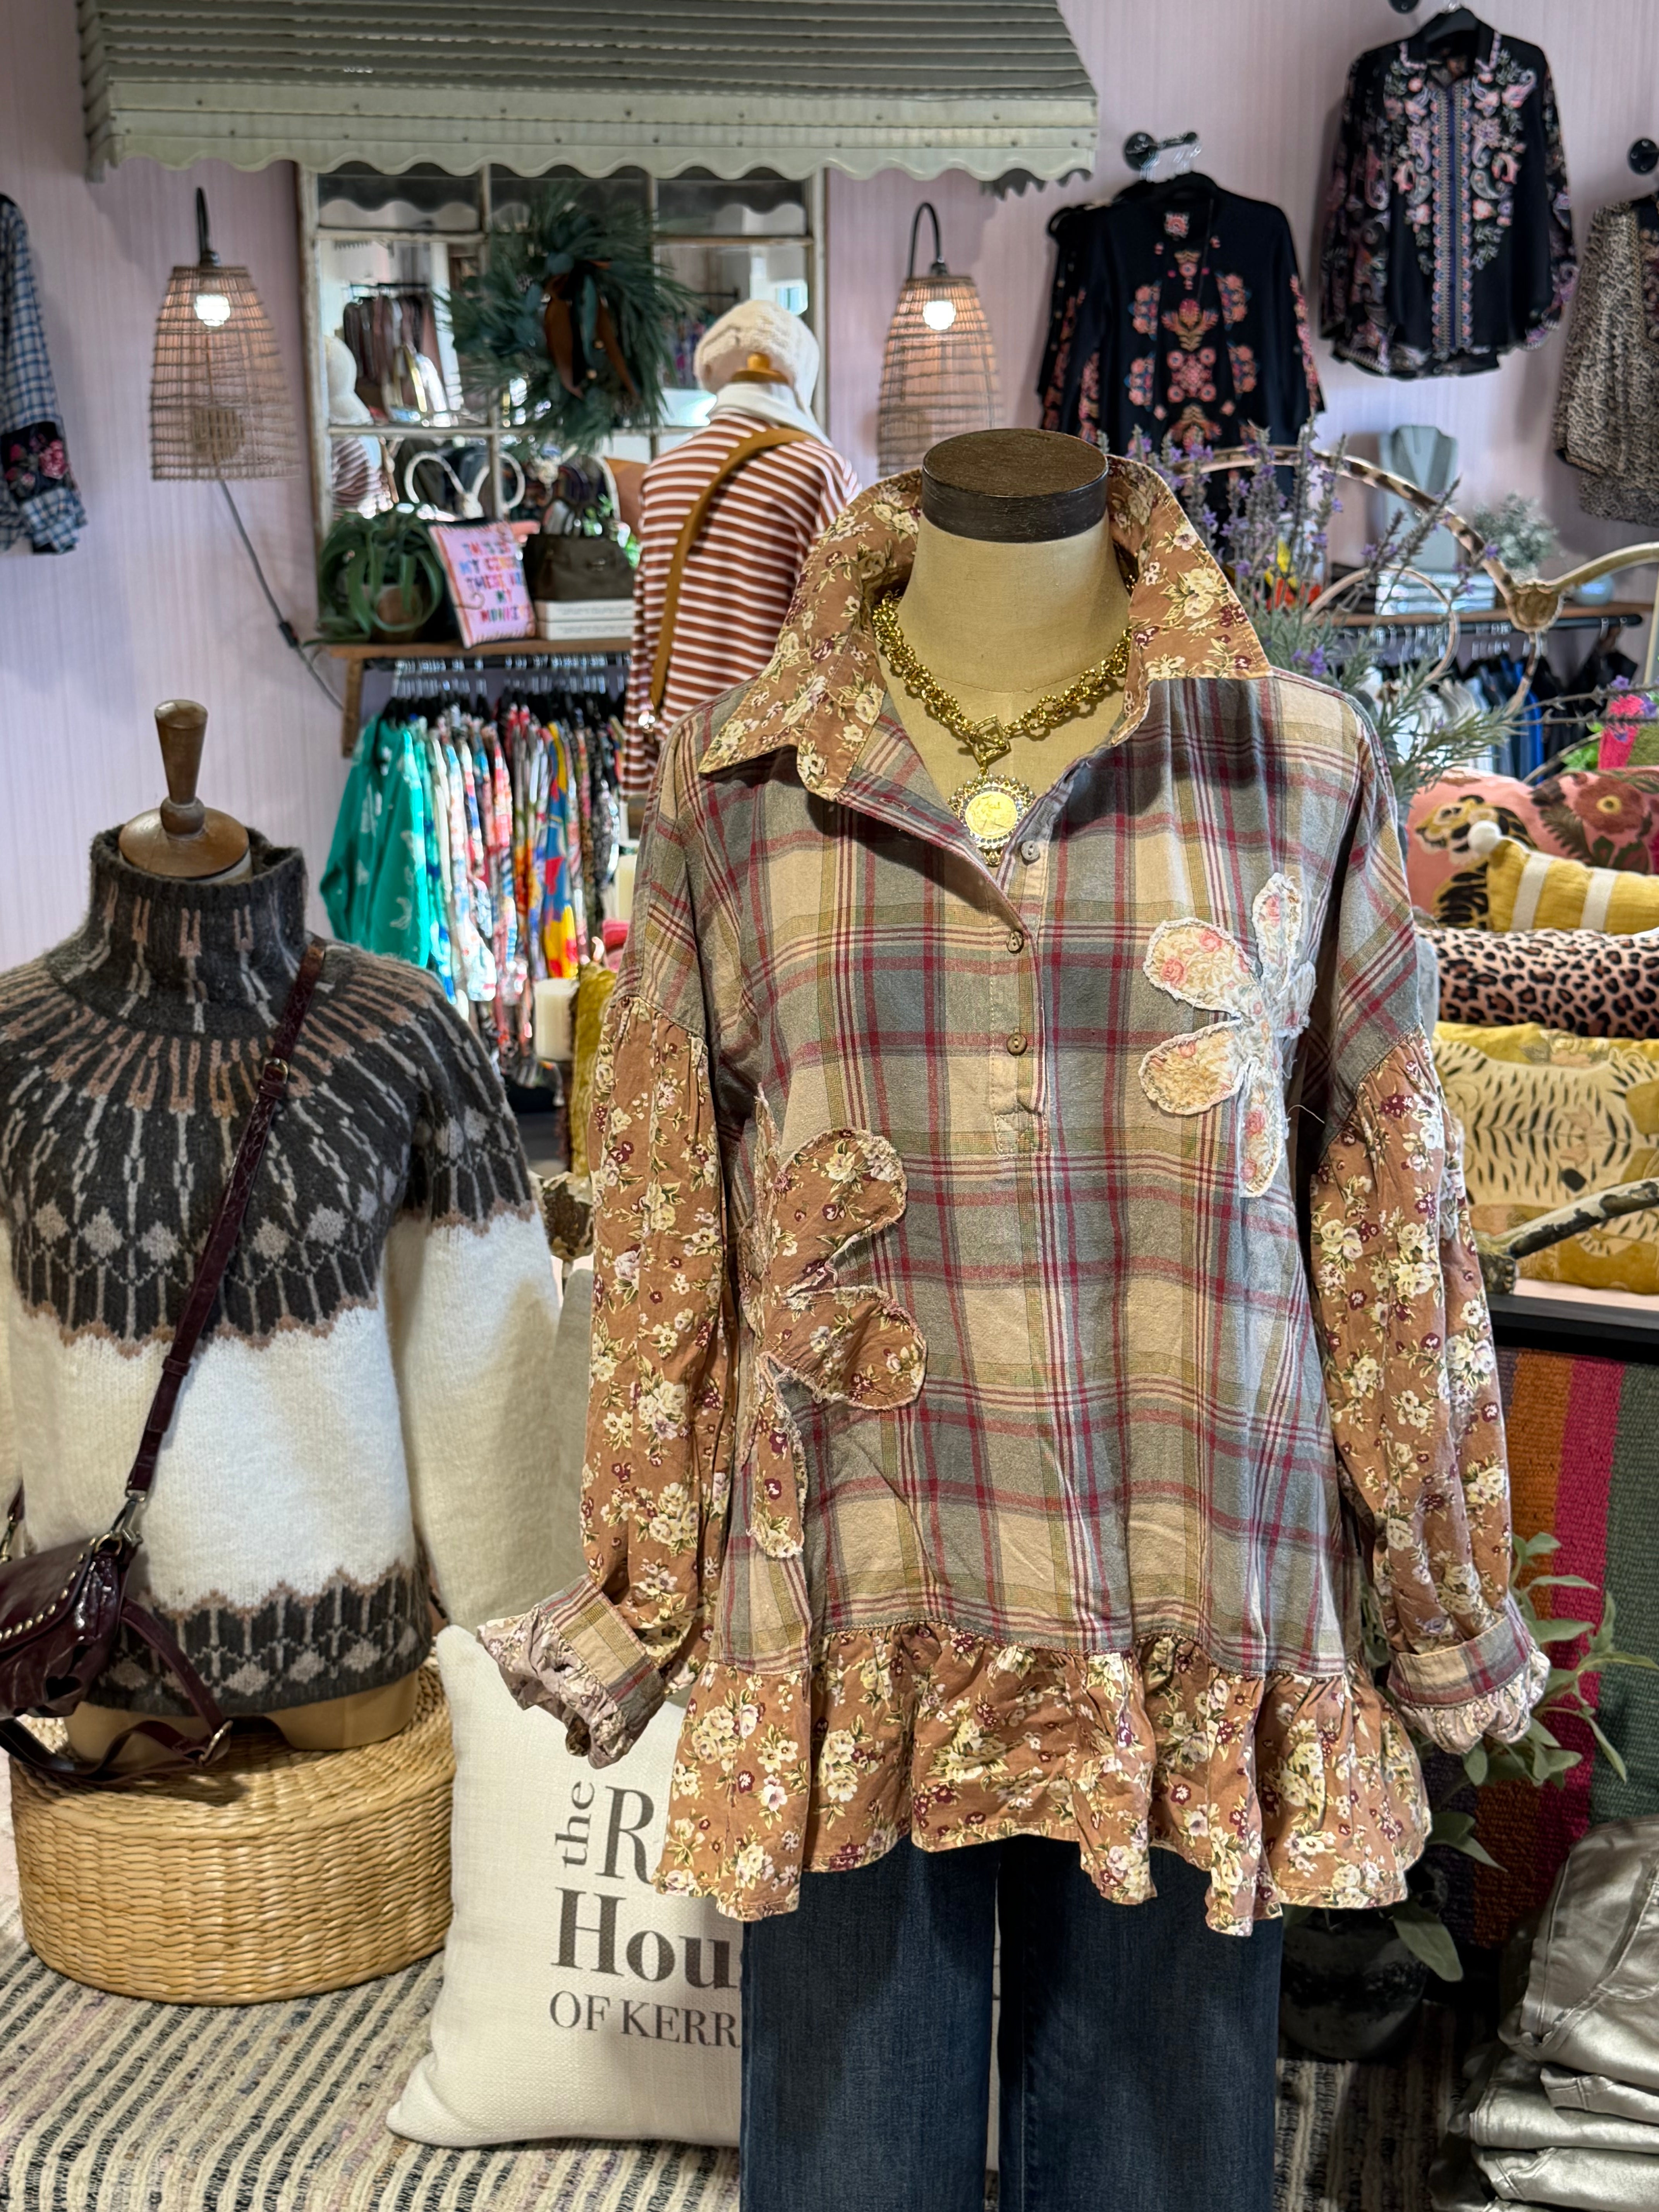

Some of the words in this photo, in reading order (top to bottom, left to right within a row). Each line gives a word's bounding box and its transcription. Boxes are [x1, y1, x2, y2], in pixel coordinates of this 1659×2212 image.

[555, 1781, 594, 1867] the
[551, 1887, 737, 1989] Hou
[550, 1990, 610, 2031] OF
[620, 1999, 740, 2048] KERR
